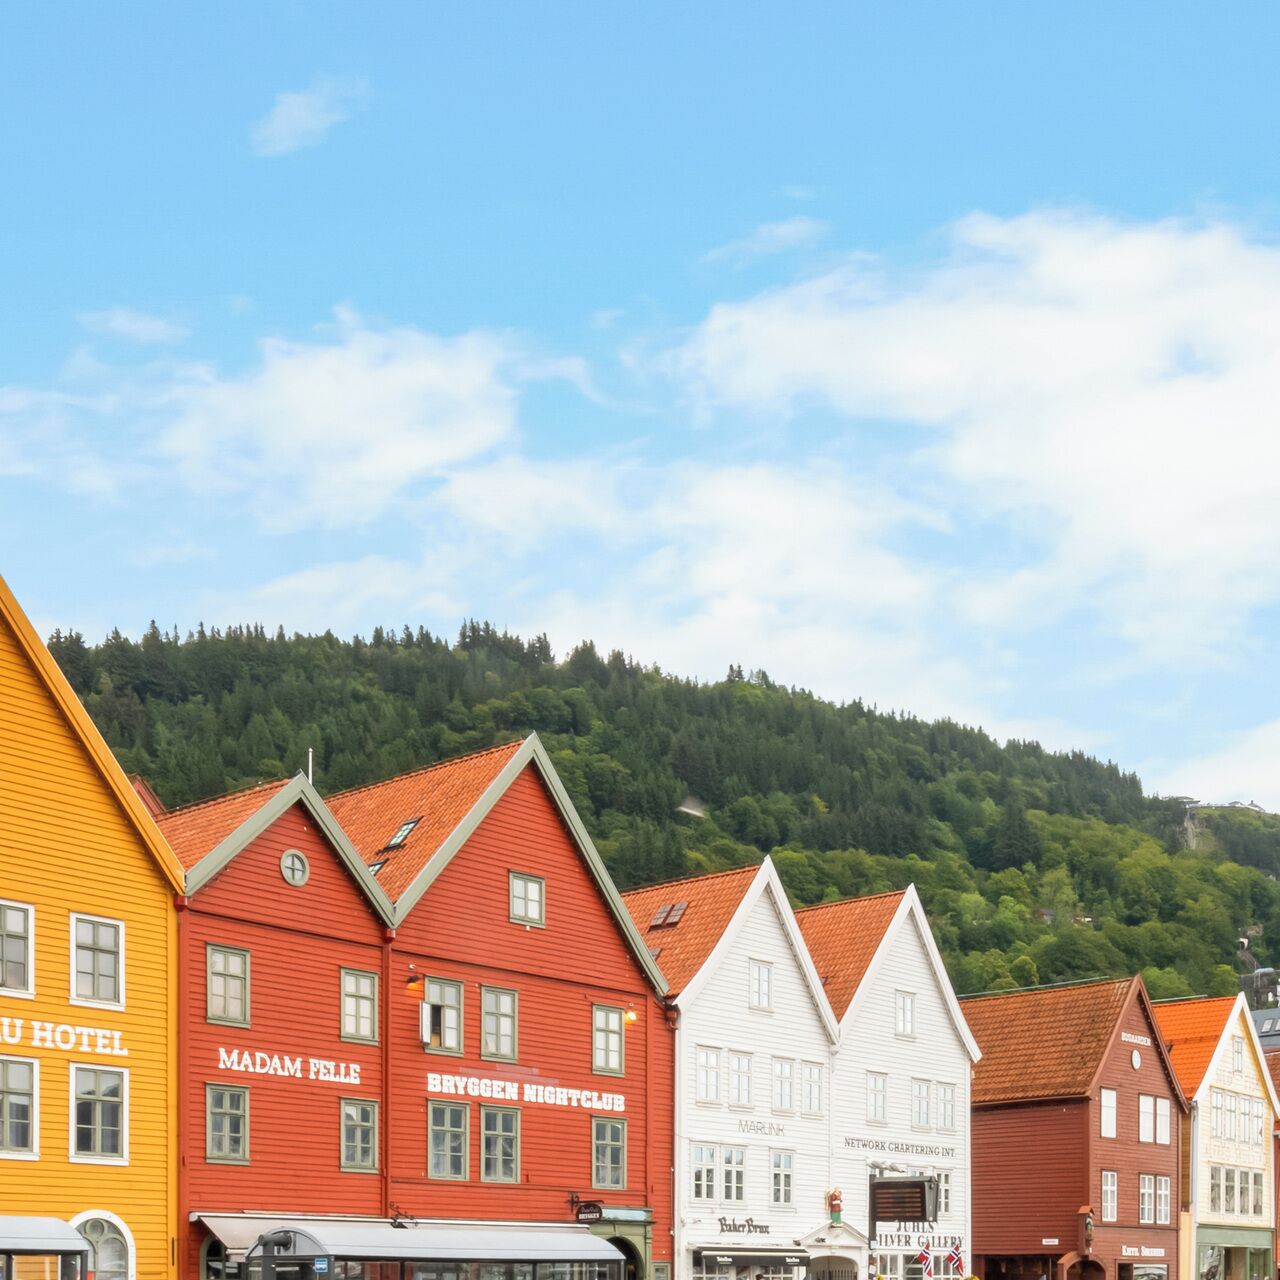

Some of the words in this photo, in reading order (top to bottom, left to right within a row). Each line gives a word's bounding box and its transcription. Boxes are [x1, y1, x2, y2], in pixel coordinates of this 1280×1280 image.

[30, 1020, 129, 1056] HOTEL
[218, 1048, 302, 1077] MADAM
[309, 1058, 361, 1084] FELLE
[427, 1073, 518, 1100] BRYGGEN
[523, 1084, 625, 1112] NIGHTCLUB
[844, 1137, 886, 1151] NETWORK
[888, 1142, 940, 1156] CHARTERING
[718, 1216, 746, 1234] Baker
